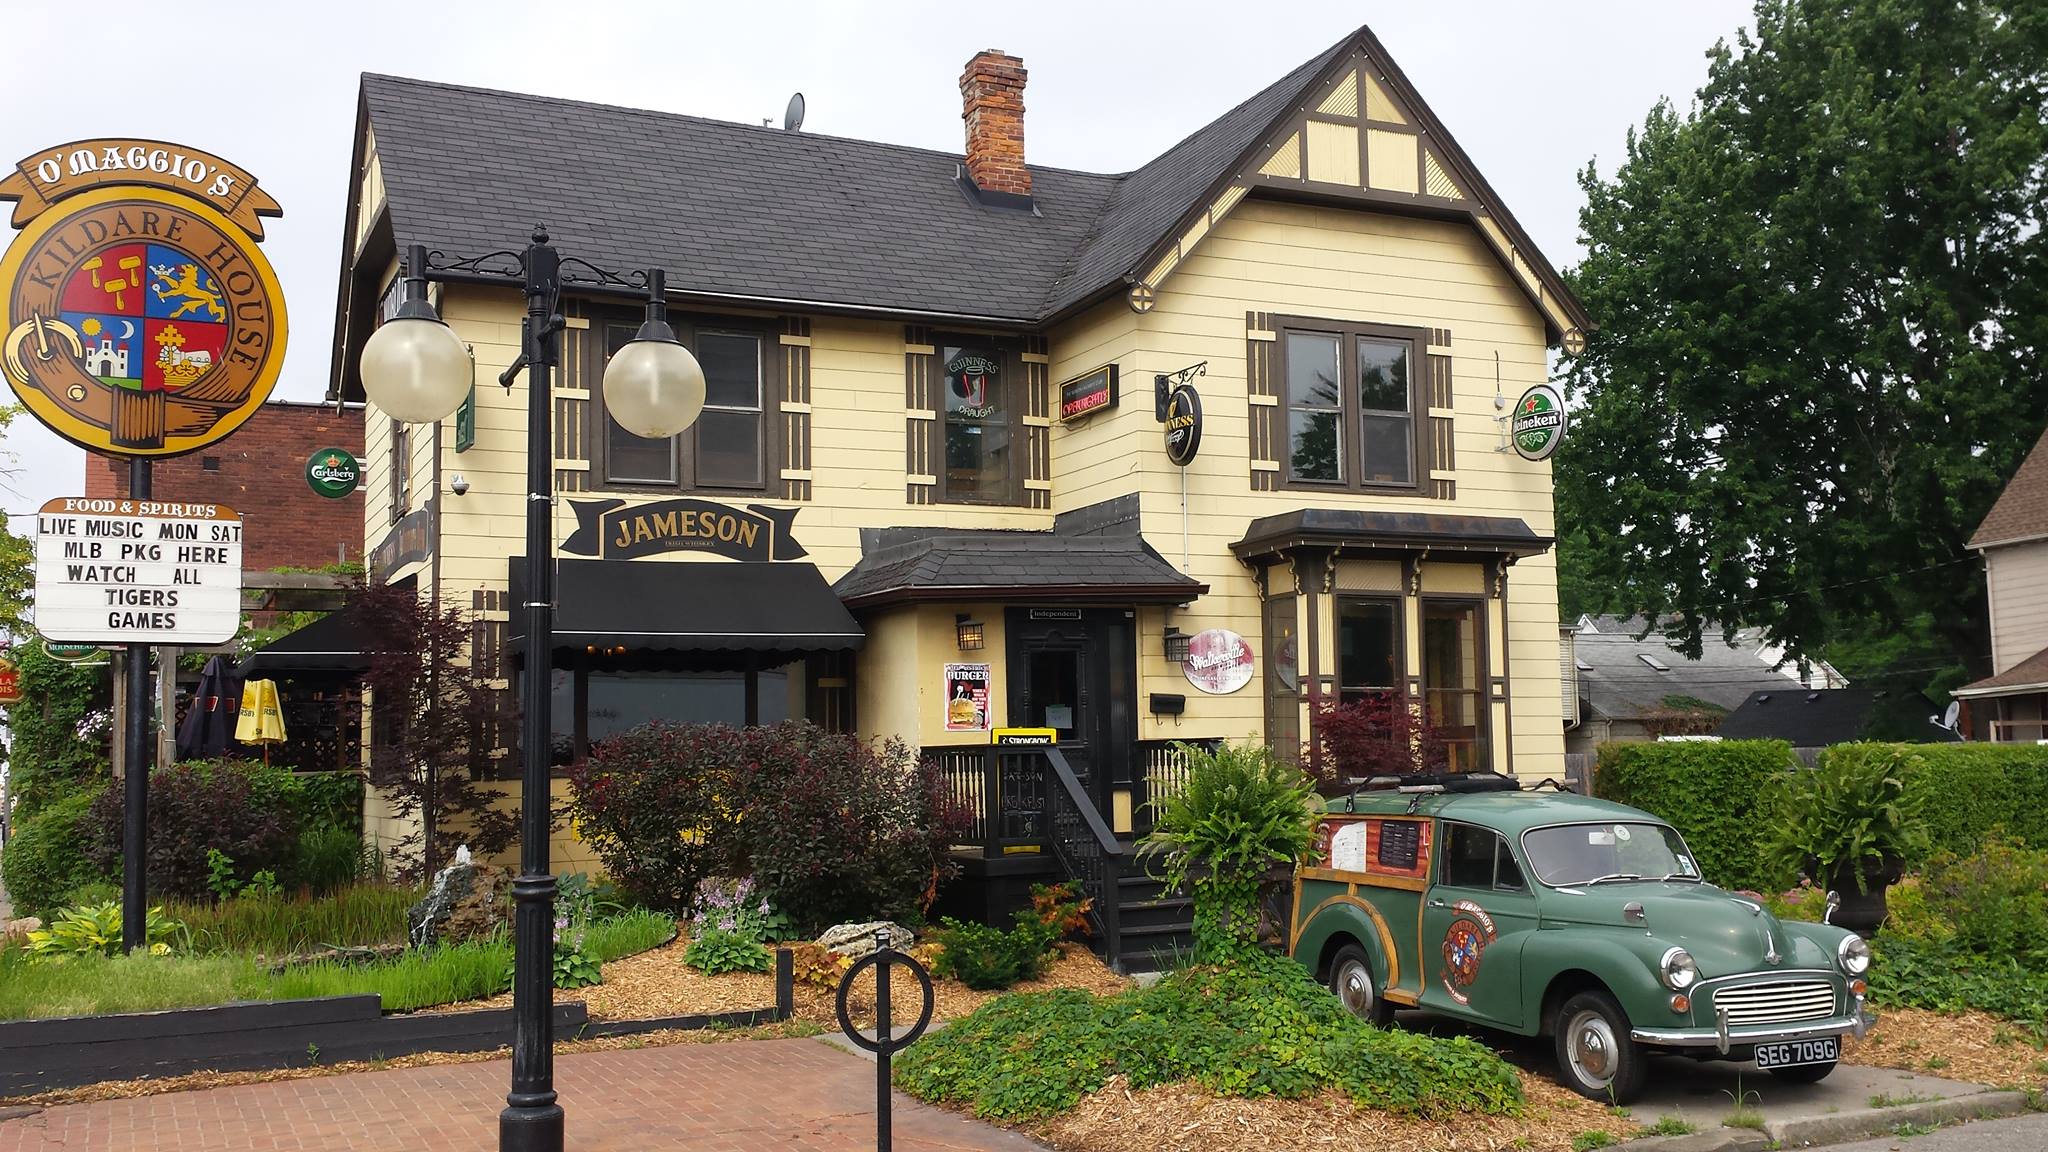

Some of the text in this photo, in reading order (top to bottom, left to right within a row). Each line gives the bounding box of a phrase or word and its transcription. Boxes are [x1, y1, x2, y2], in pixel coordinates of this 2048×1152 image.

[38, 146, 235, 196] O'MAGGIO'S
[29, 210, 264, 372] KILDARE HOUSE
[949, 356, 999, 374] GUINNESS
[958, 405, 994, 418] DRAUGHT
[1513, 414, 1558, 432] eineken
[311, 465, 355, 482] Carlsberg
[64, 499, 217, 518] FOOD & SPIRITS
[39, 518, 241, 542] LIVE MUSIC MON SAT
[615, 511, 760, 548] JAMESON
[64, 542, 228, 564] MLB PKG HERE
[67, 565, 202, 585] WATCH ALL
[105, 589, 178, 606] TIGERS
[108, 612, 176, 629] GAMES
[947, 671, 989, 681] BURGER
[1757, 1041, 1835, 1066] SEG 709G
